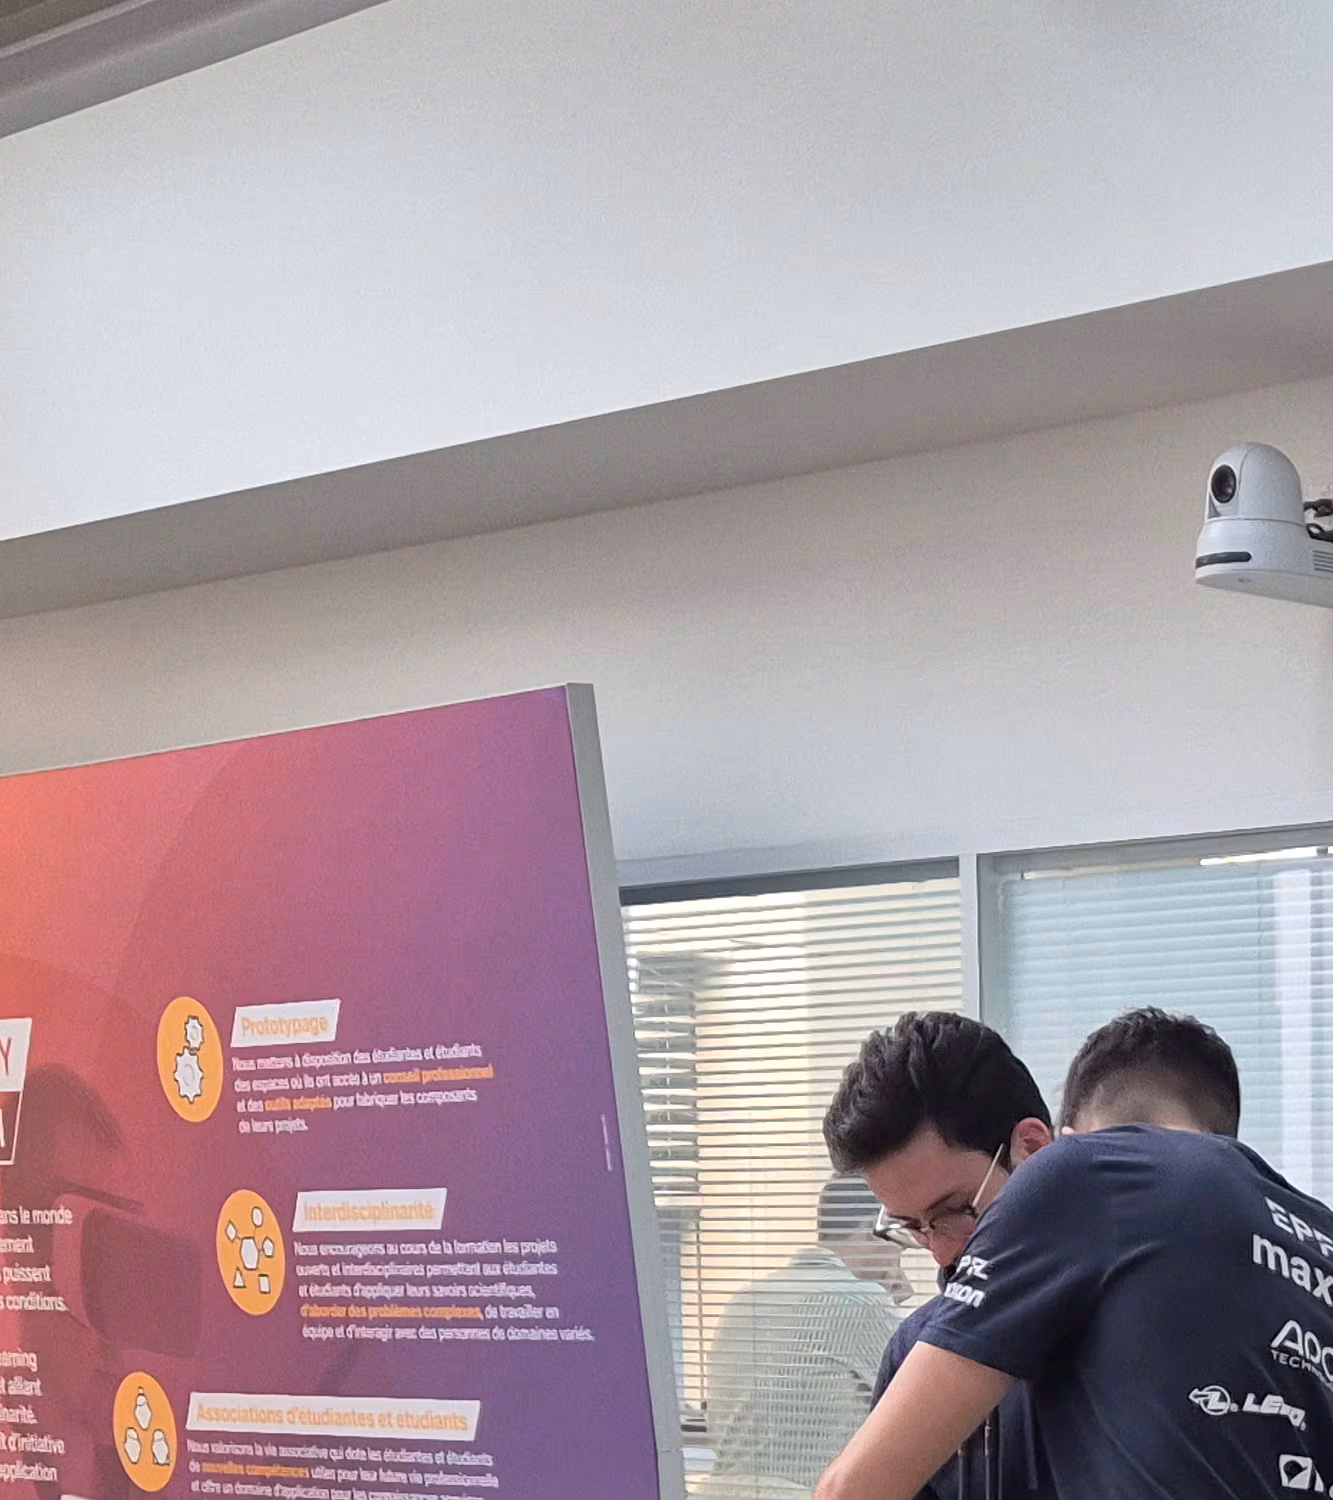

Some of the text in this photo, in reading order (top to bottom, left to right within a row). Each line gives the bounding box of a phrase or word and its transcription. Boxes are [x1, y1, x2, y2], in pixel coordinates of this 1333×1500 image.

[241, 1015, 328, 1037] Prototypage
[19, 1205, 30, 1224] le
[32, 1205, 73, 1225] monde
[197, 1405, 283, 1424] Associations
[377, 1410, 393, 1428] et
[397, 1408, 468, 1431] étudiants
